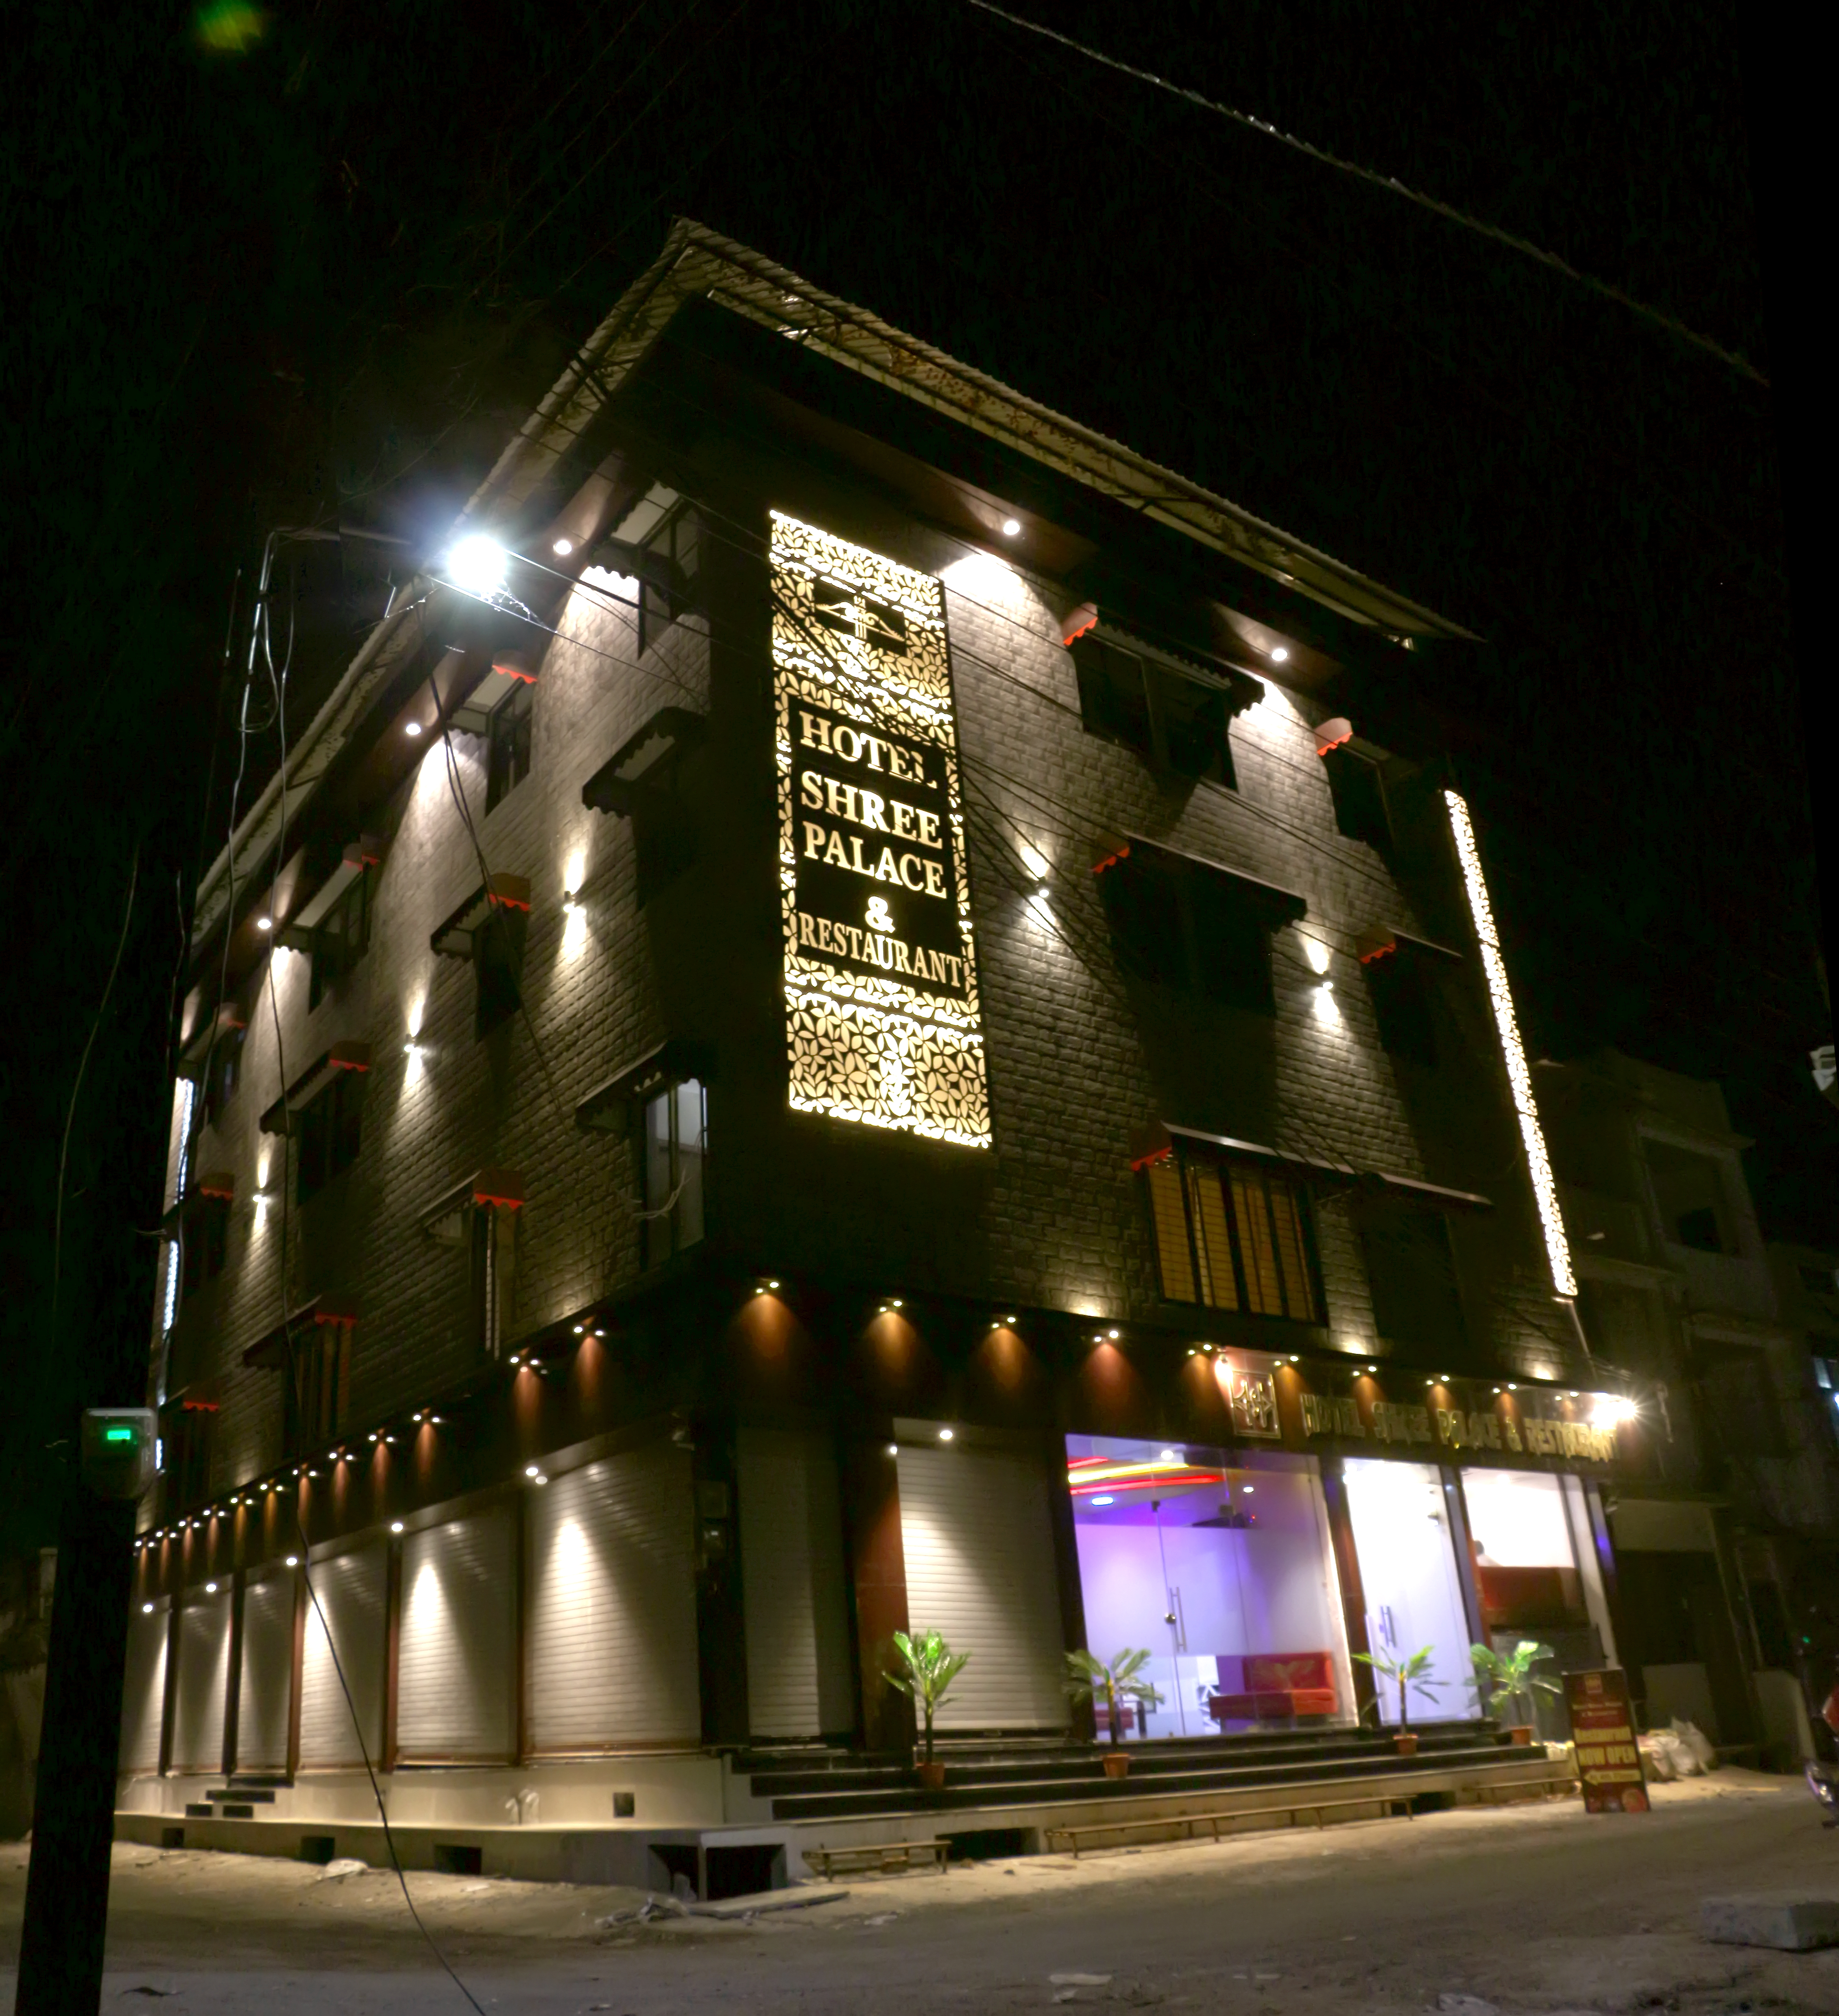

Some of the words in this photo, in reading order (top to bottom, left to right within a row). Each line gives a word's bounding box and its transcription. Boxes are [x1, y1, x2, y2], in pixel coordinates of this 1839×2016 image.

[799, 711, 937, 789] HOTEL
[801, 771, 943, 849] SHREE
[802, 820, 947, 899] PALACE
[798, 912, 962, 987] RESTAURANT
[865, 896, 896, 934] &
[1606, 1744, 1637, 1765] OPEN
